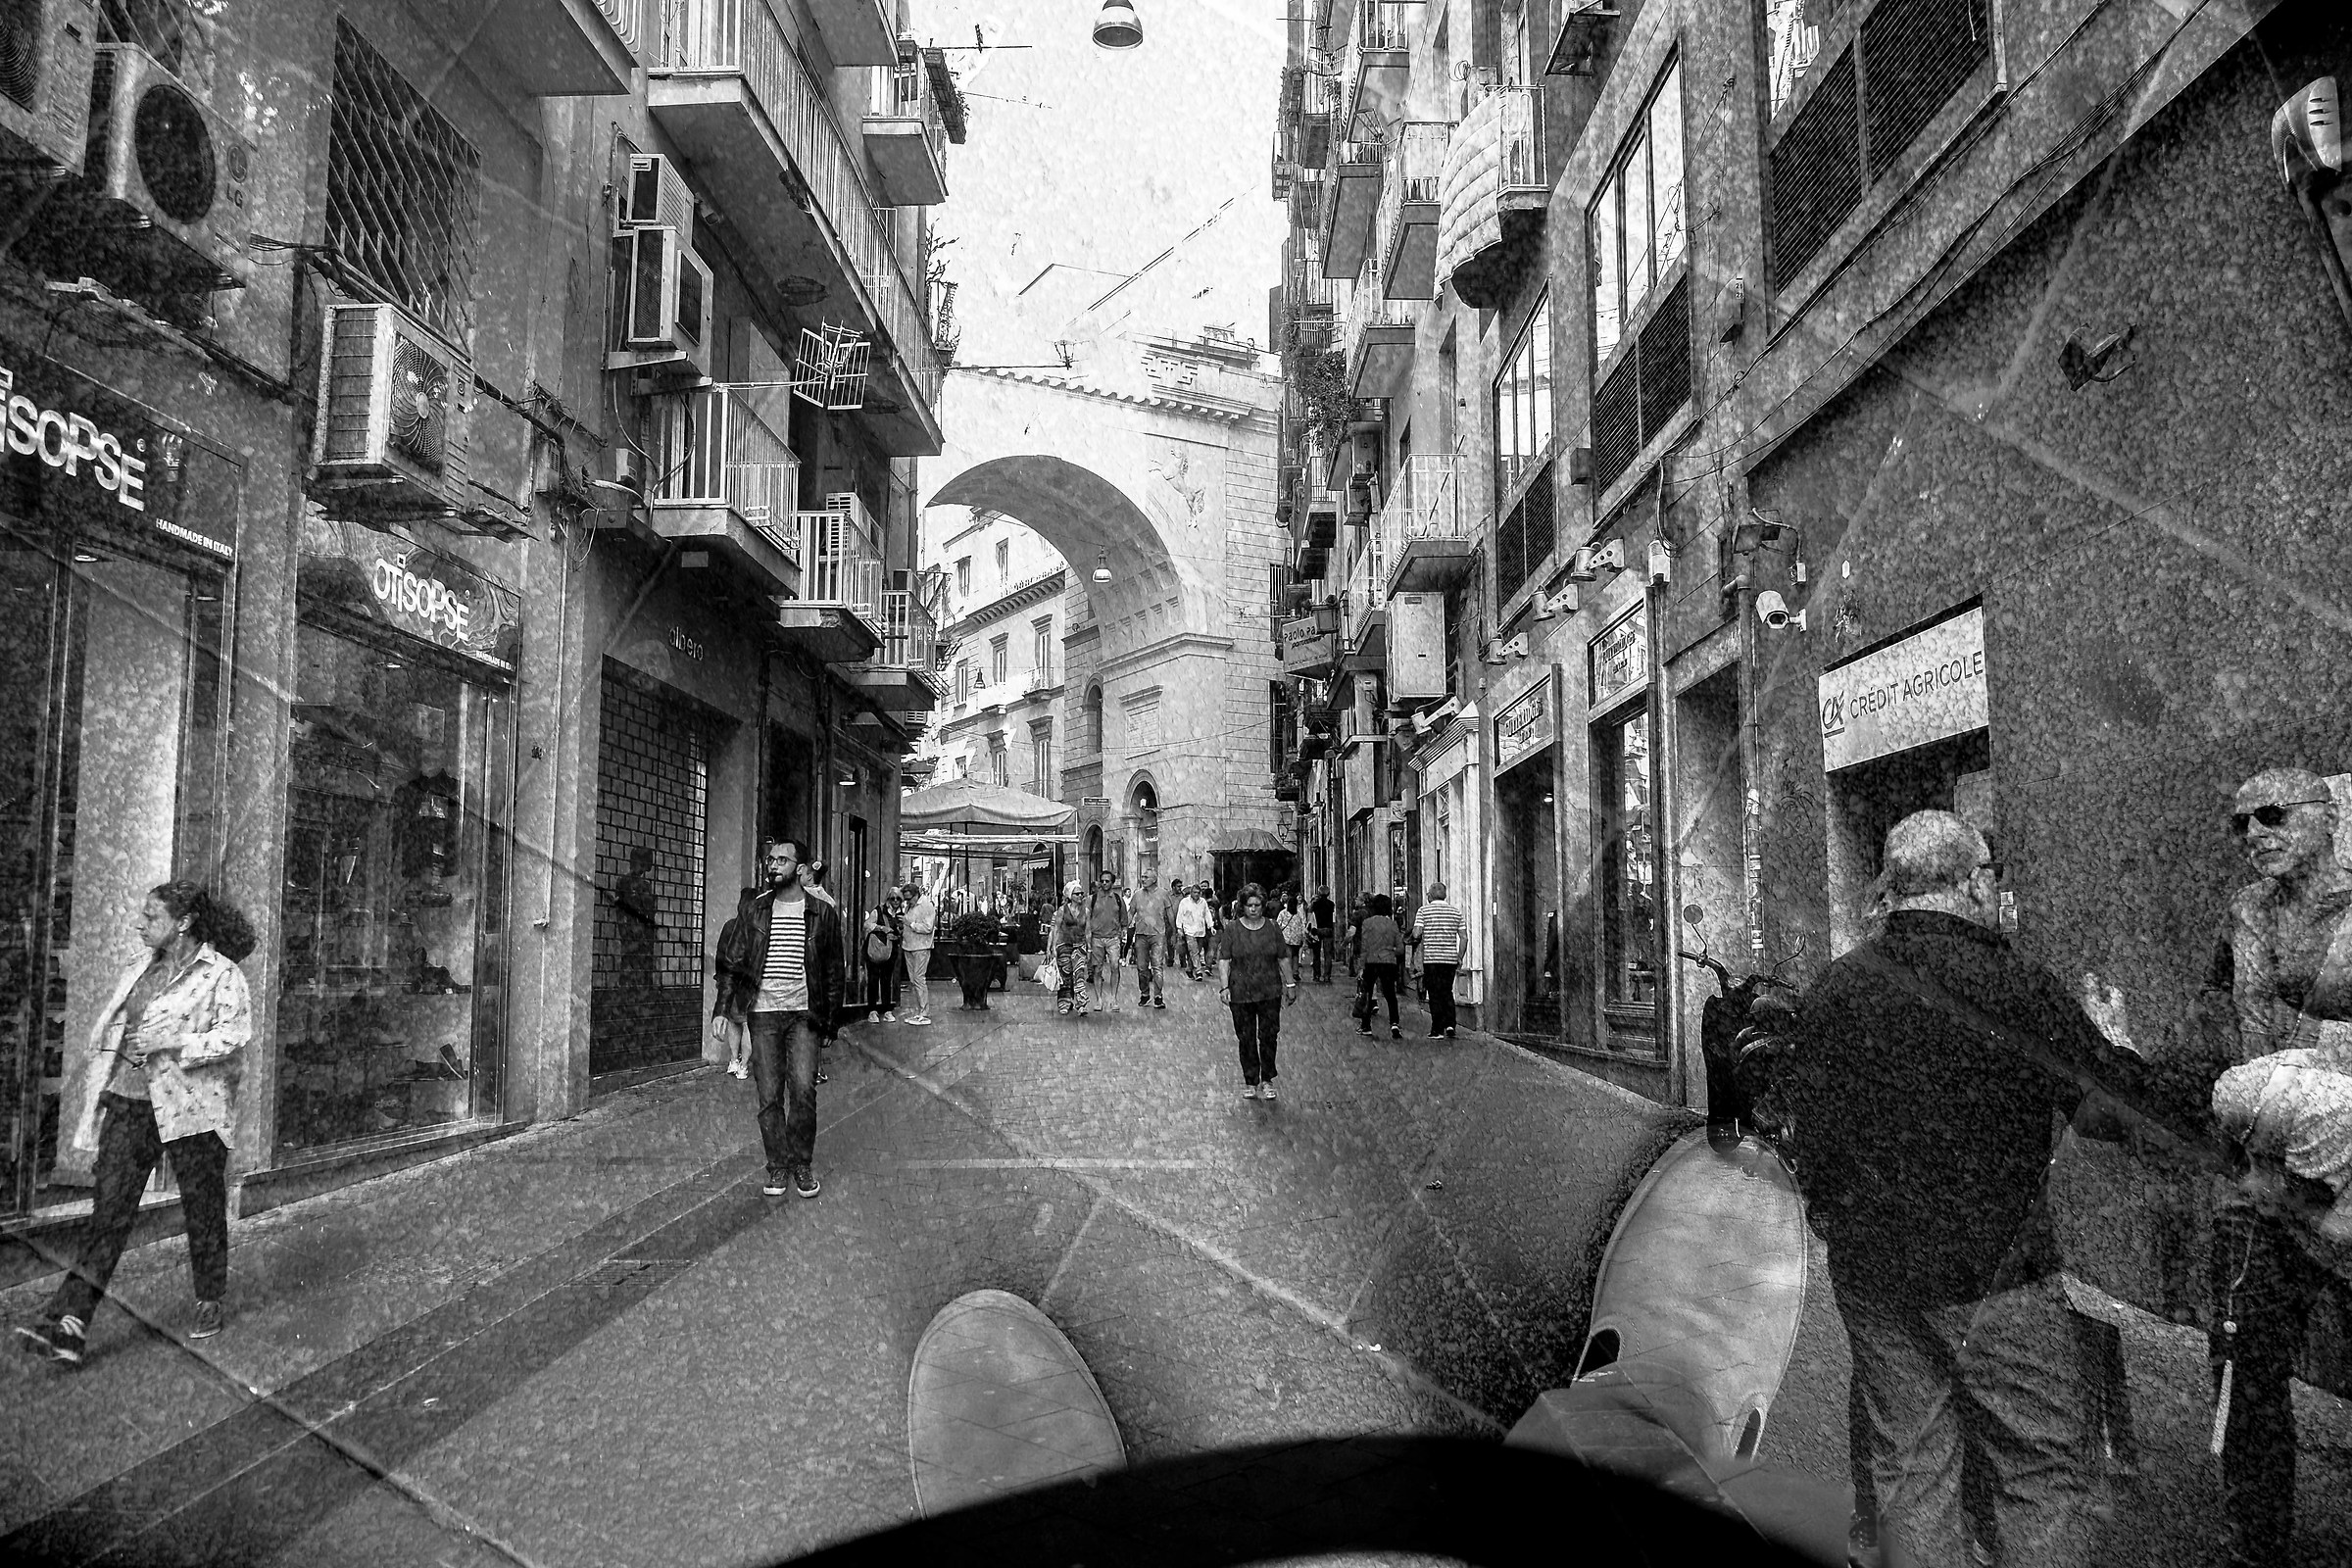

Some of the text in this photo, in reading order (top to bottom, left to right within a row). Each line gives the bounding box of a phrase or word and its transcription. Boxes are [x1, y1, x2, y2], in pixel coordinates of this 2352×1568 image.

[226, 183, 243, 209] LG
[156, 518, 233, 557] HANDMADE IN ITALY
[668, 625, 704, 662] albero
[1849, 682, 1899, 720] CRÉDIT
[1903, 651, 1984, 702] AGRICOLE
